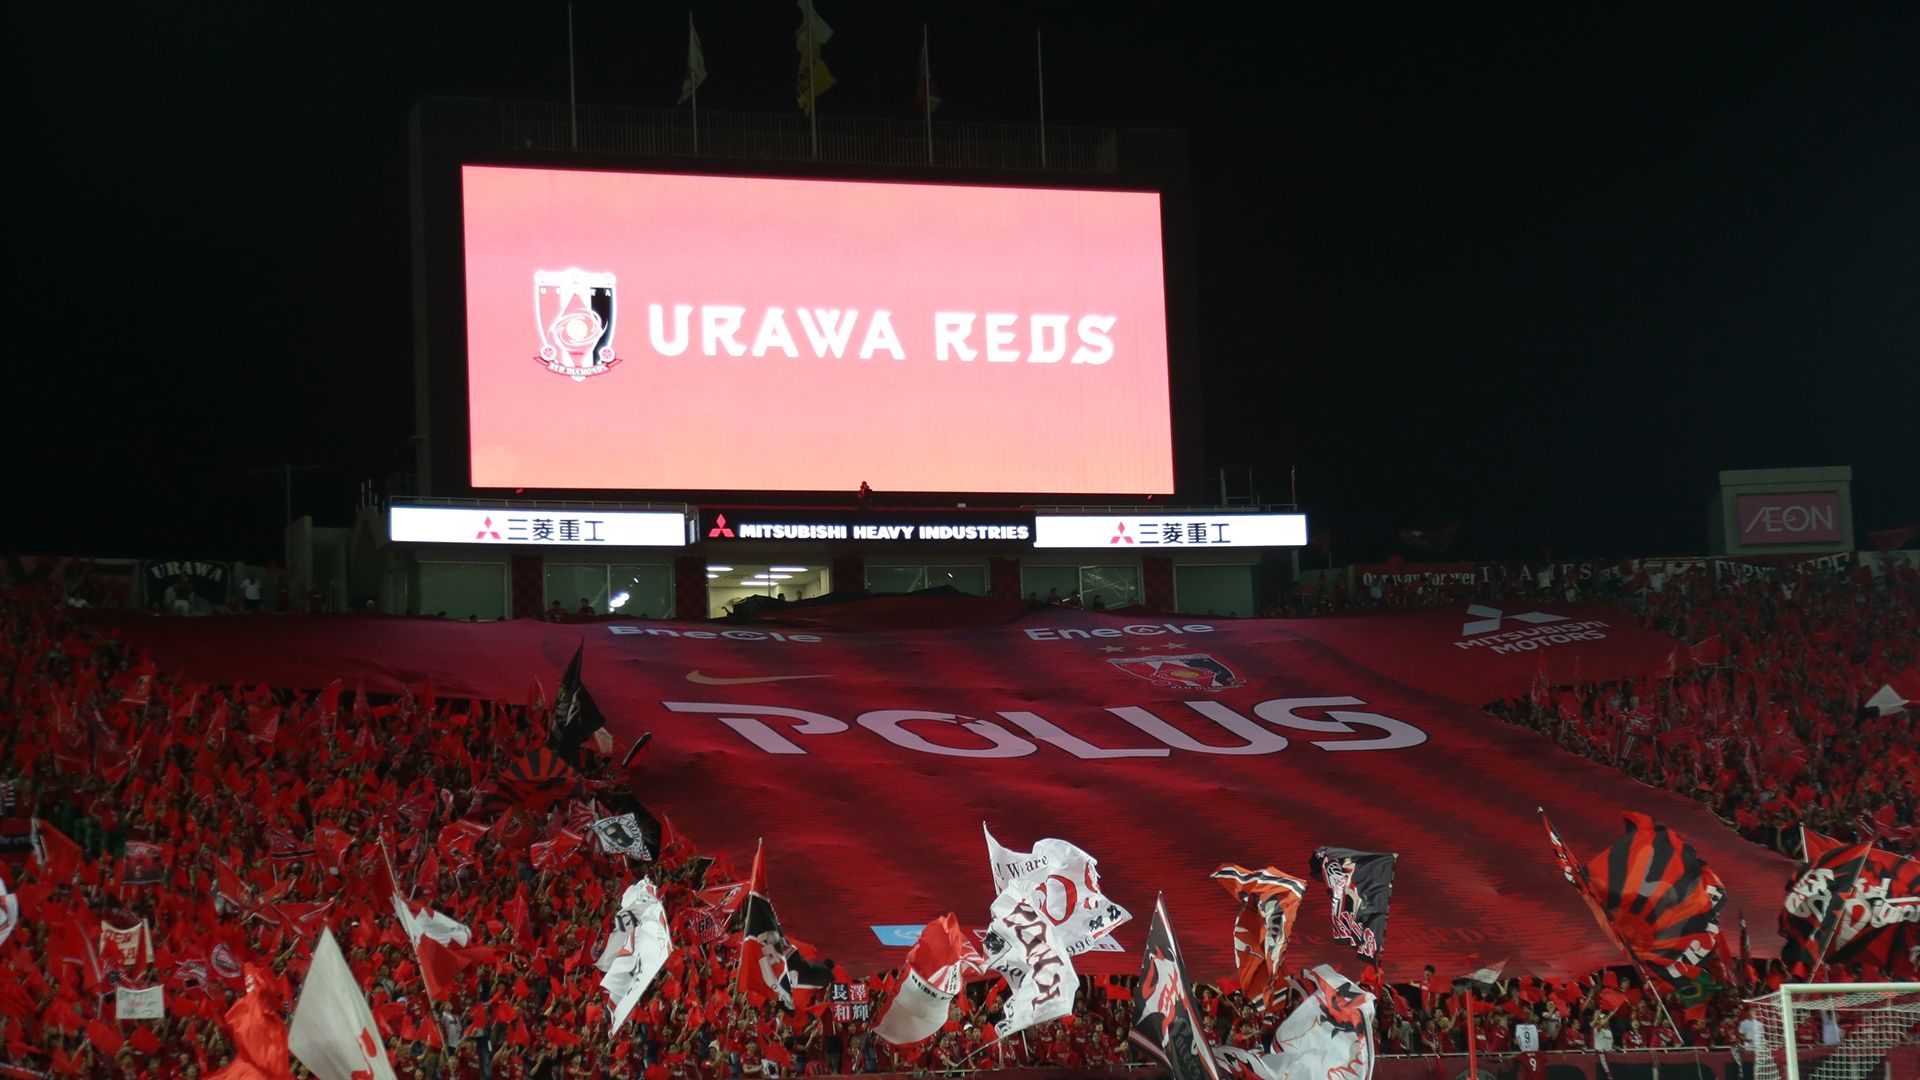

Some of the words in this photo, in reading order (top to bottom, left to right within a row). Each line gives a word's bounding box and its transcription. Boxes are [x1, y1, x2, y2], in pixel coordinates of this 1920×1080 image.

[648, 303, 906, 360] URAWA
[934, 311, 1118, 365] REDS
[507, 519, 605, 542] 三菱重工
[739, 524, 847, 539] MITSUBISHI
[853, 525, 914, 540] HEAVY
[919, 526, 1029, 540] INDUSTRIES
[1138, 522, 1231, 544] 三菱重工
[151, 561, 224, 582] URAWA
[608, 626, 823, 643] EneCle
[1022, 623, 1215, 642] EneCle
[1453, 620, 1612, 650] MITSUBISHI
[1489, 630, 1607, 655] MOTORS
[661, 696, 1428, 760] POLUS
[832, 984, 866, 1001] 長澤
[1524, 1031, 1531, 1044] 9
[1529, 1058, 1537, 1072] 9
